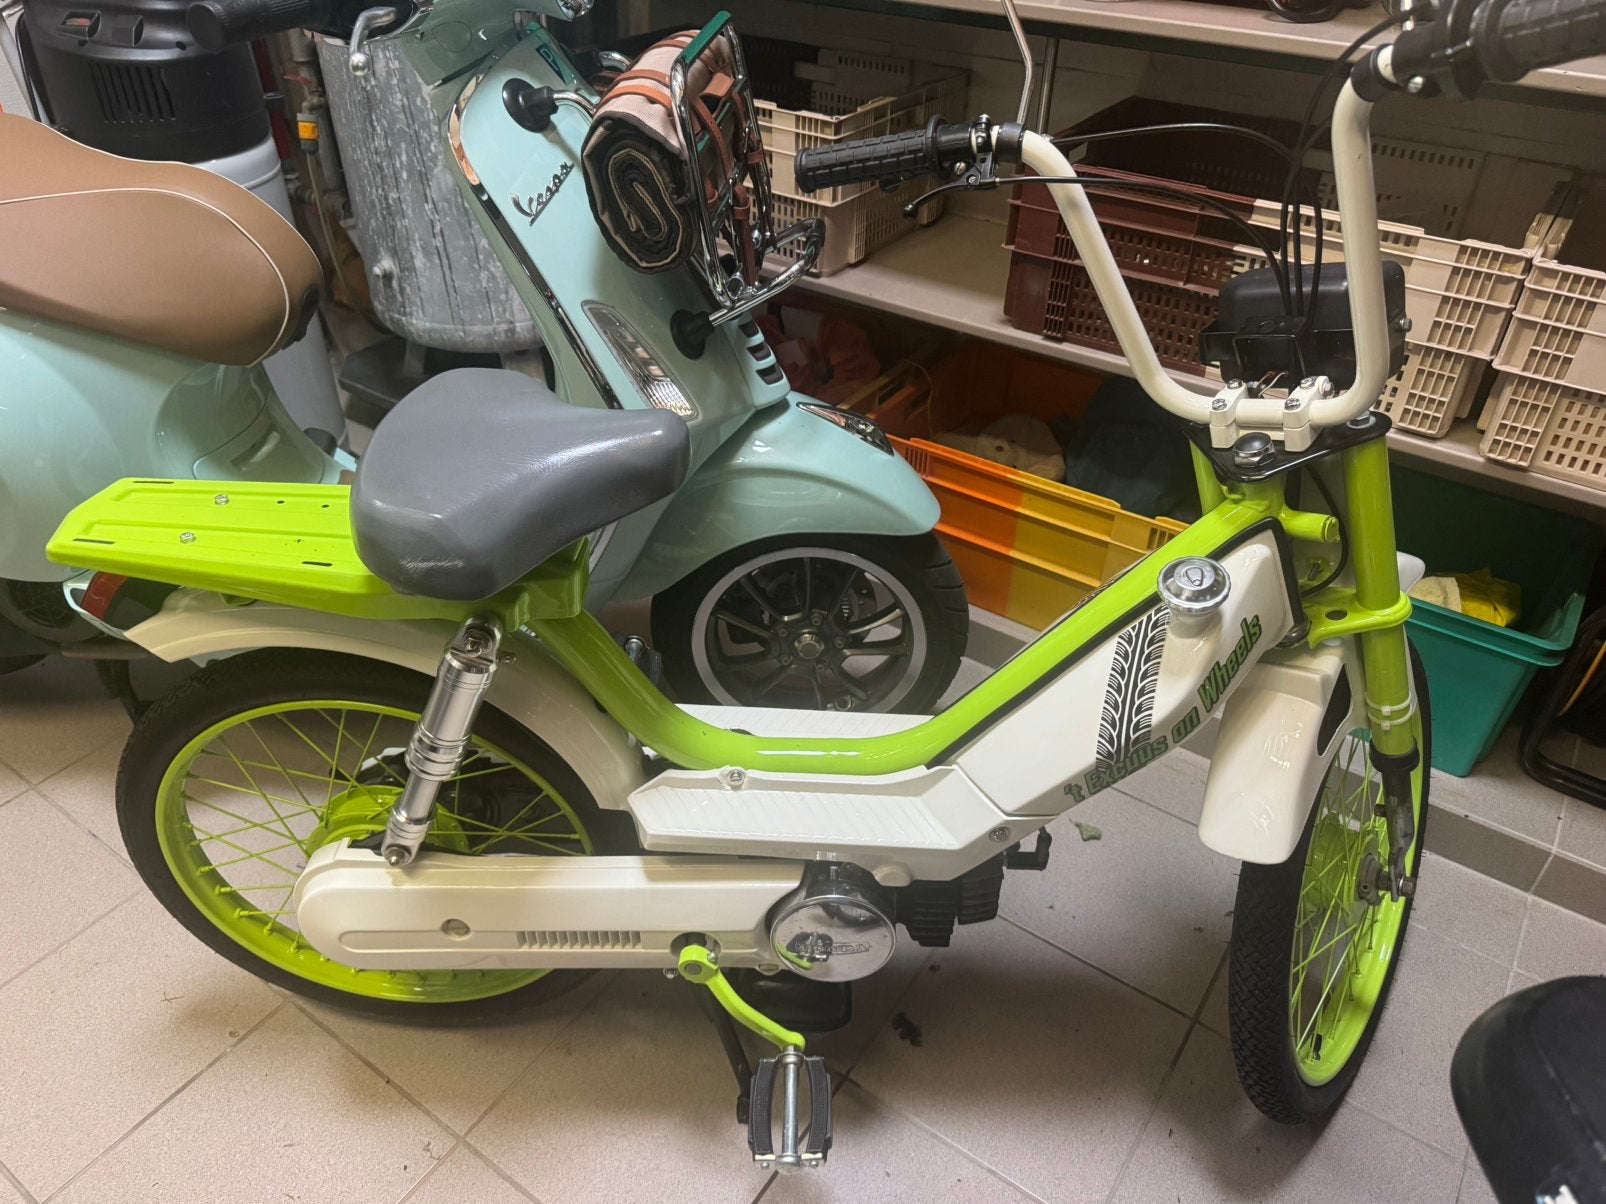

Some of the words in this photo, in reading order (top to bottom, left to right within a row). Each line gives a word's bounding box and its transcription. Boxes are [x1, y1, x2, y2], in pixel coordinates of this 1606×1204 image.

[511, 161, 575, 227] Vespa
[1171, 706, 1201, 744] on
[1197, 614, 1264, 713] Wheels
